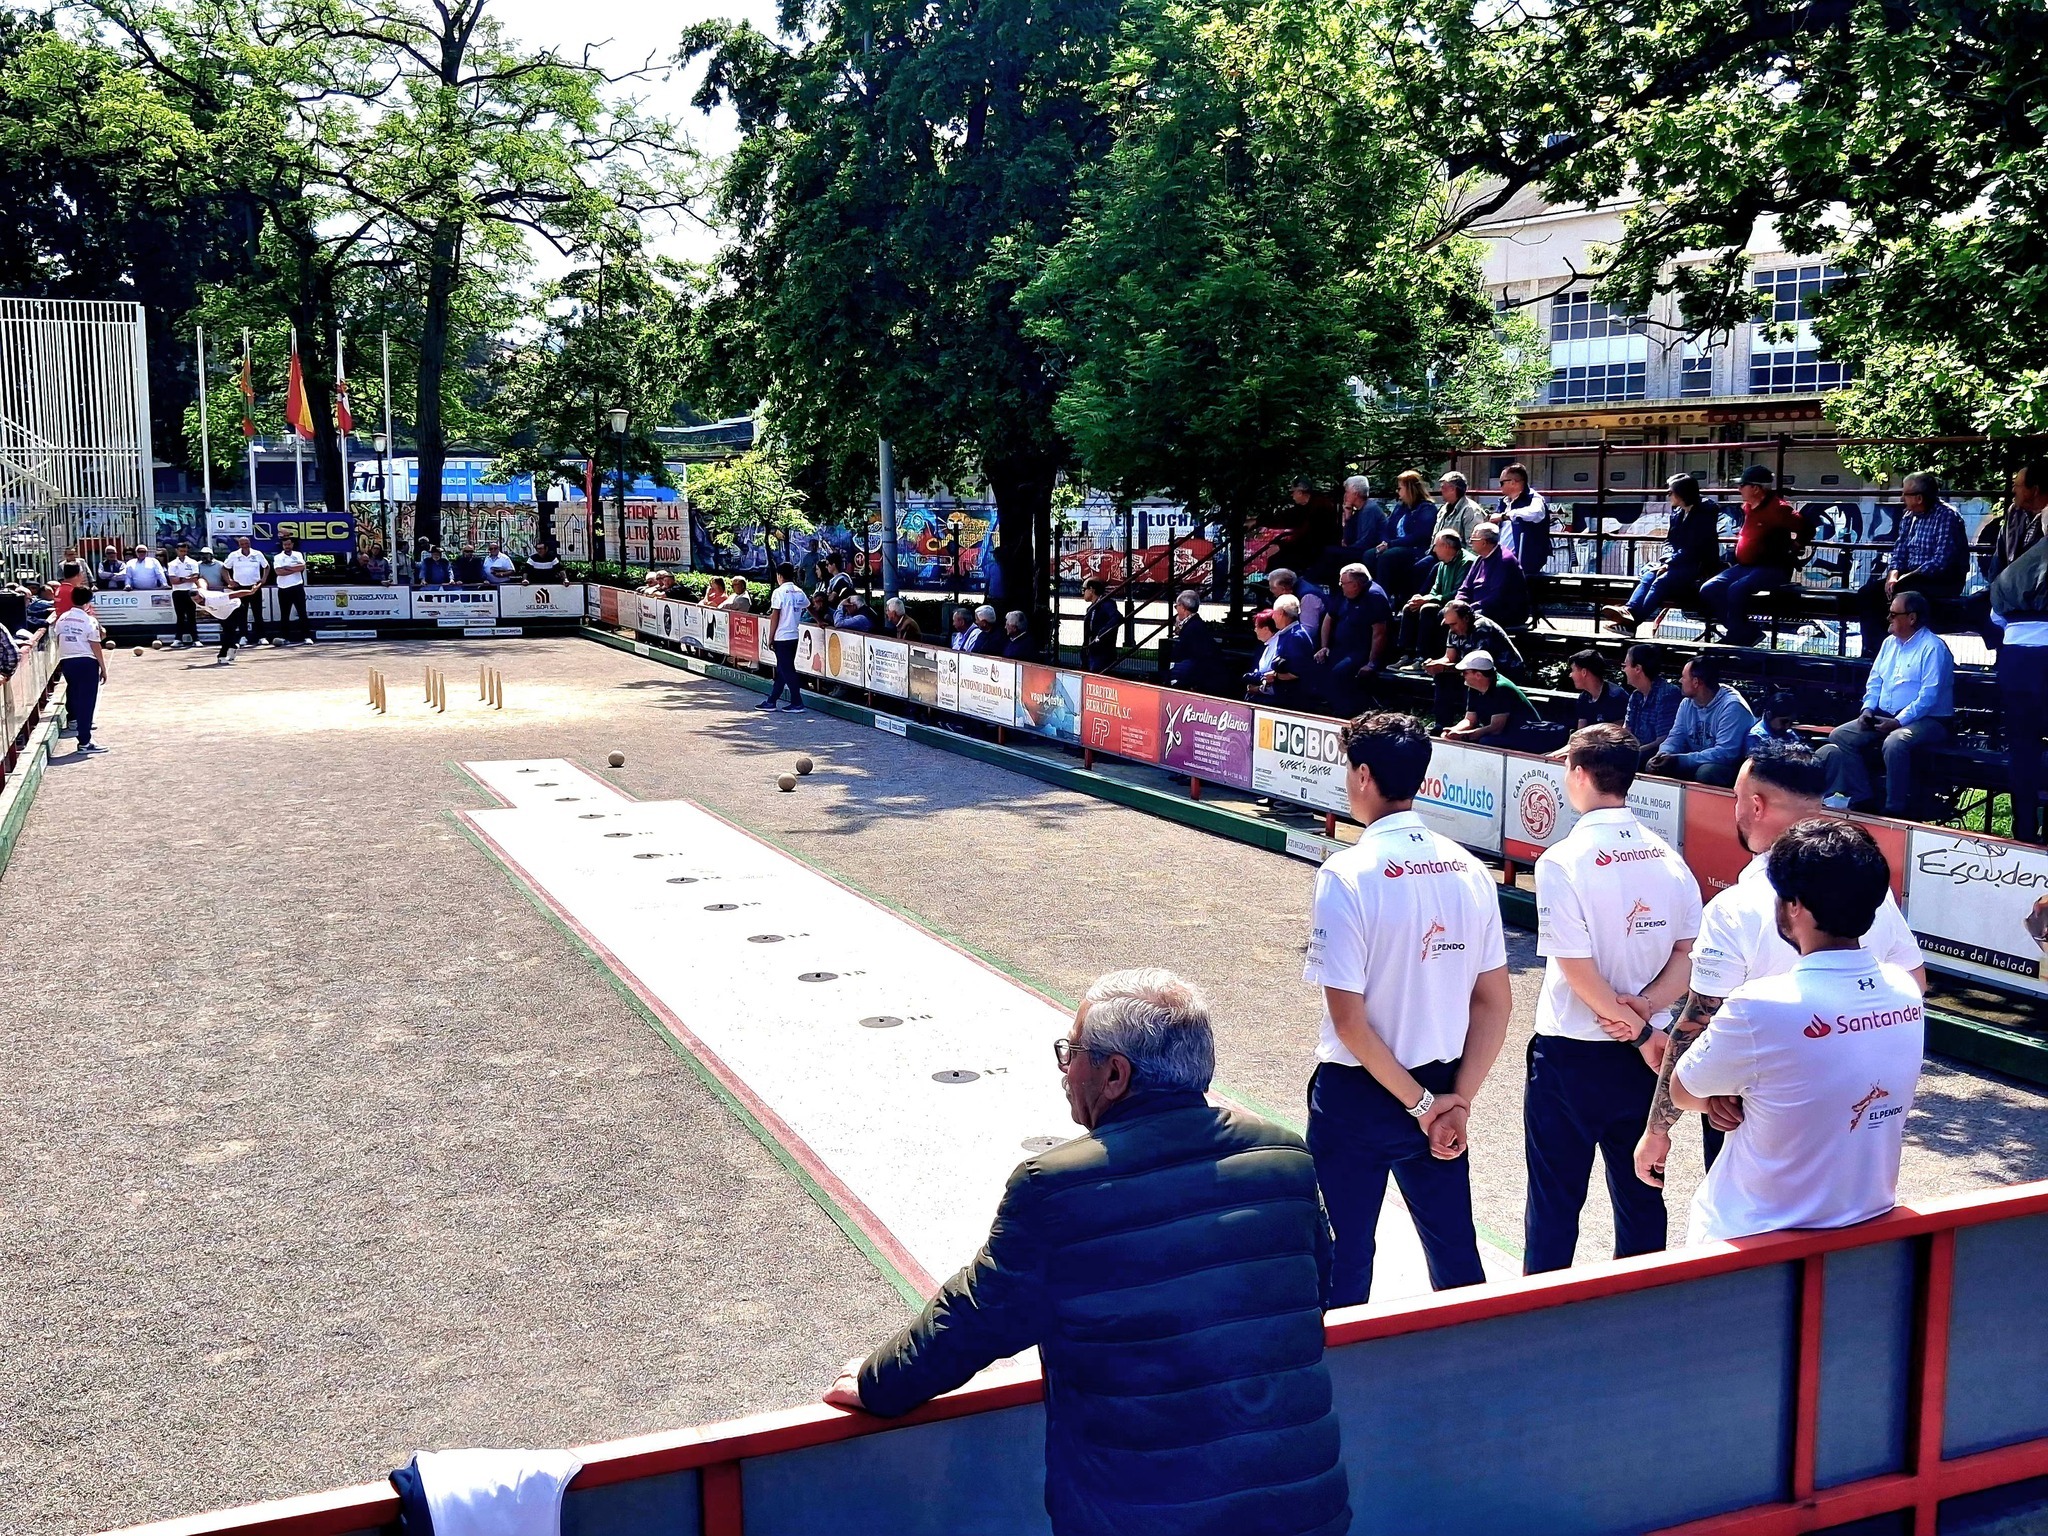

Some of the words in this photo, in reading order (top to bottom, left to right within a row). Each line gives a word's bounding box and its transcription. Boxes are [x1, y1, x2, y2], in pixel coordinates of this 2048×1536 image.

[618, 504, 658, 521] EFIENDE
[667, 504, 679, 520] LA
[217, 520, 224, 529] 0
[241, 520, 247, 529] 3
[277, 521, 350, 540] SIEC
[619, 526, 654, 541] ULTUR
[657, 526, 680, 541] BASE
[635, 547, 647, 561] TU
[100, 594, 139, 606] Freire
[1181, 703, 1218, 726] Karolina
[1217, 710, 1250, 732] Blanco
[1419, 773, 1494, 811] oroSanJusto
[1513, 769, 1549, 799] CANTABRIA
[1650, 797, 1671, 810] HOGAR
[1437, 943, 1465, 951] PENDO
[1969, 948, 1988, 964] del
[1992, 954, 2033, 975] helado
[1836, 1005, 1922, 1034] Santander
[1879, 1105, 1903, 1119] PENDO
